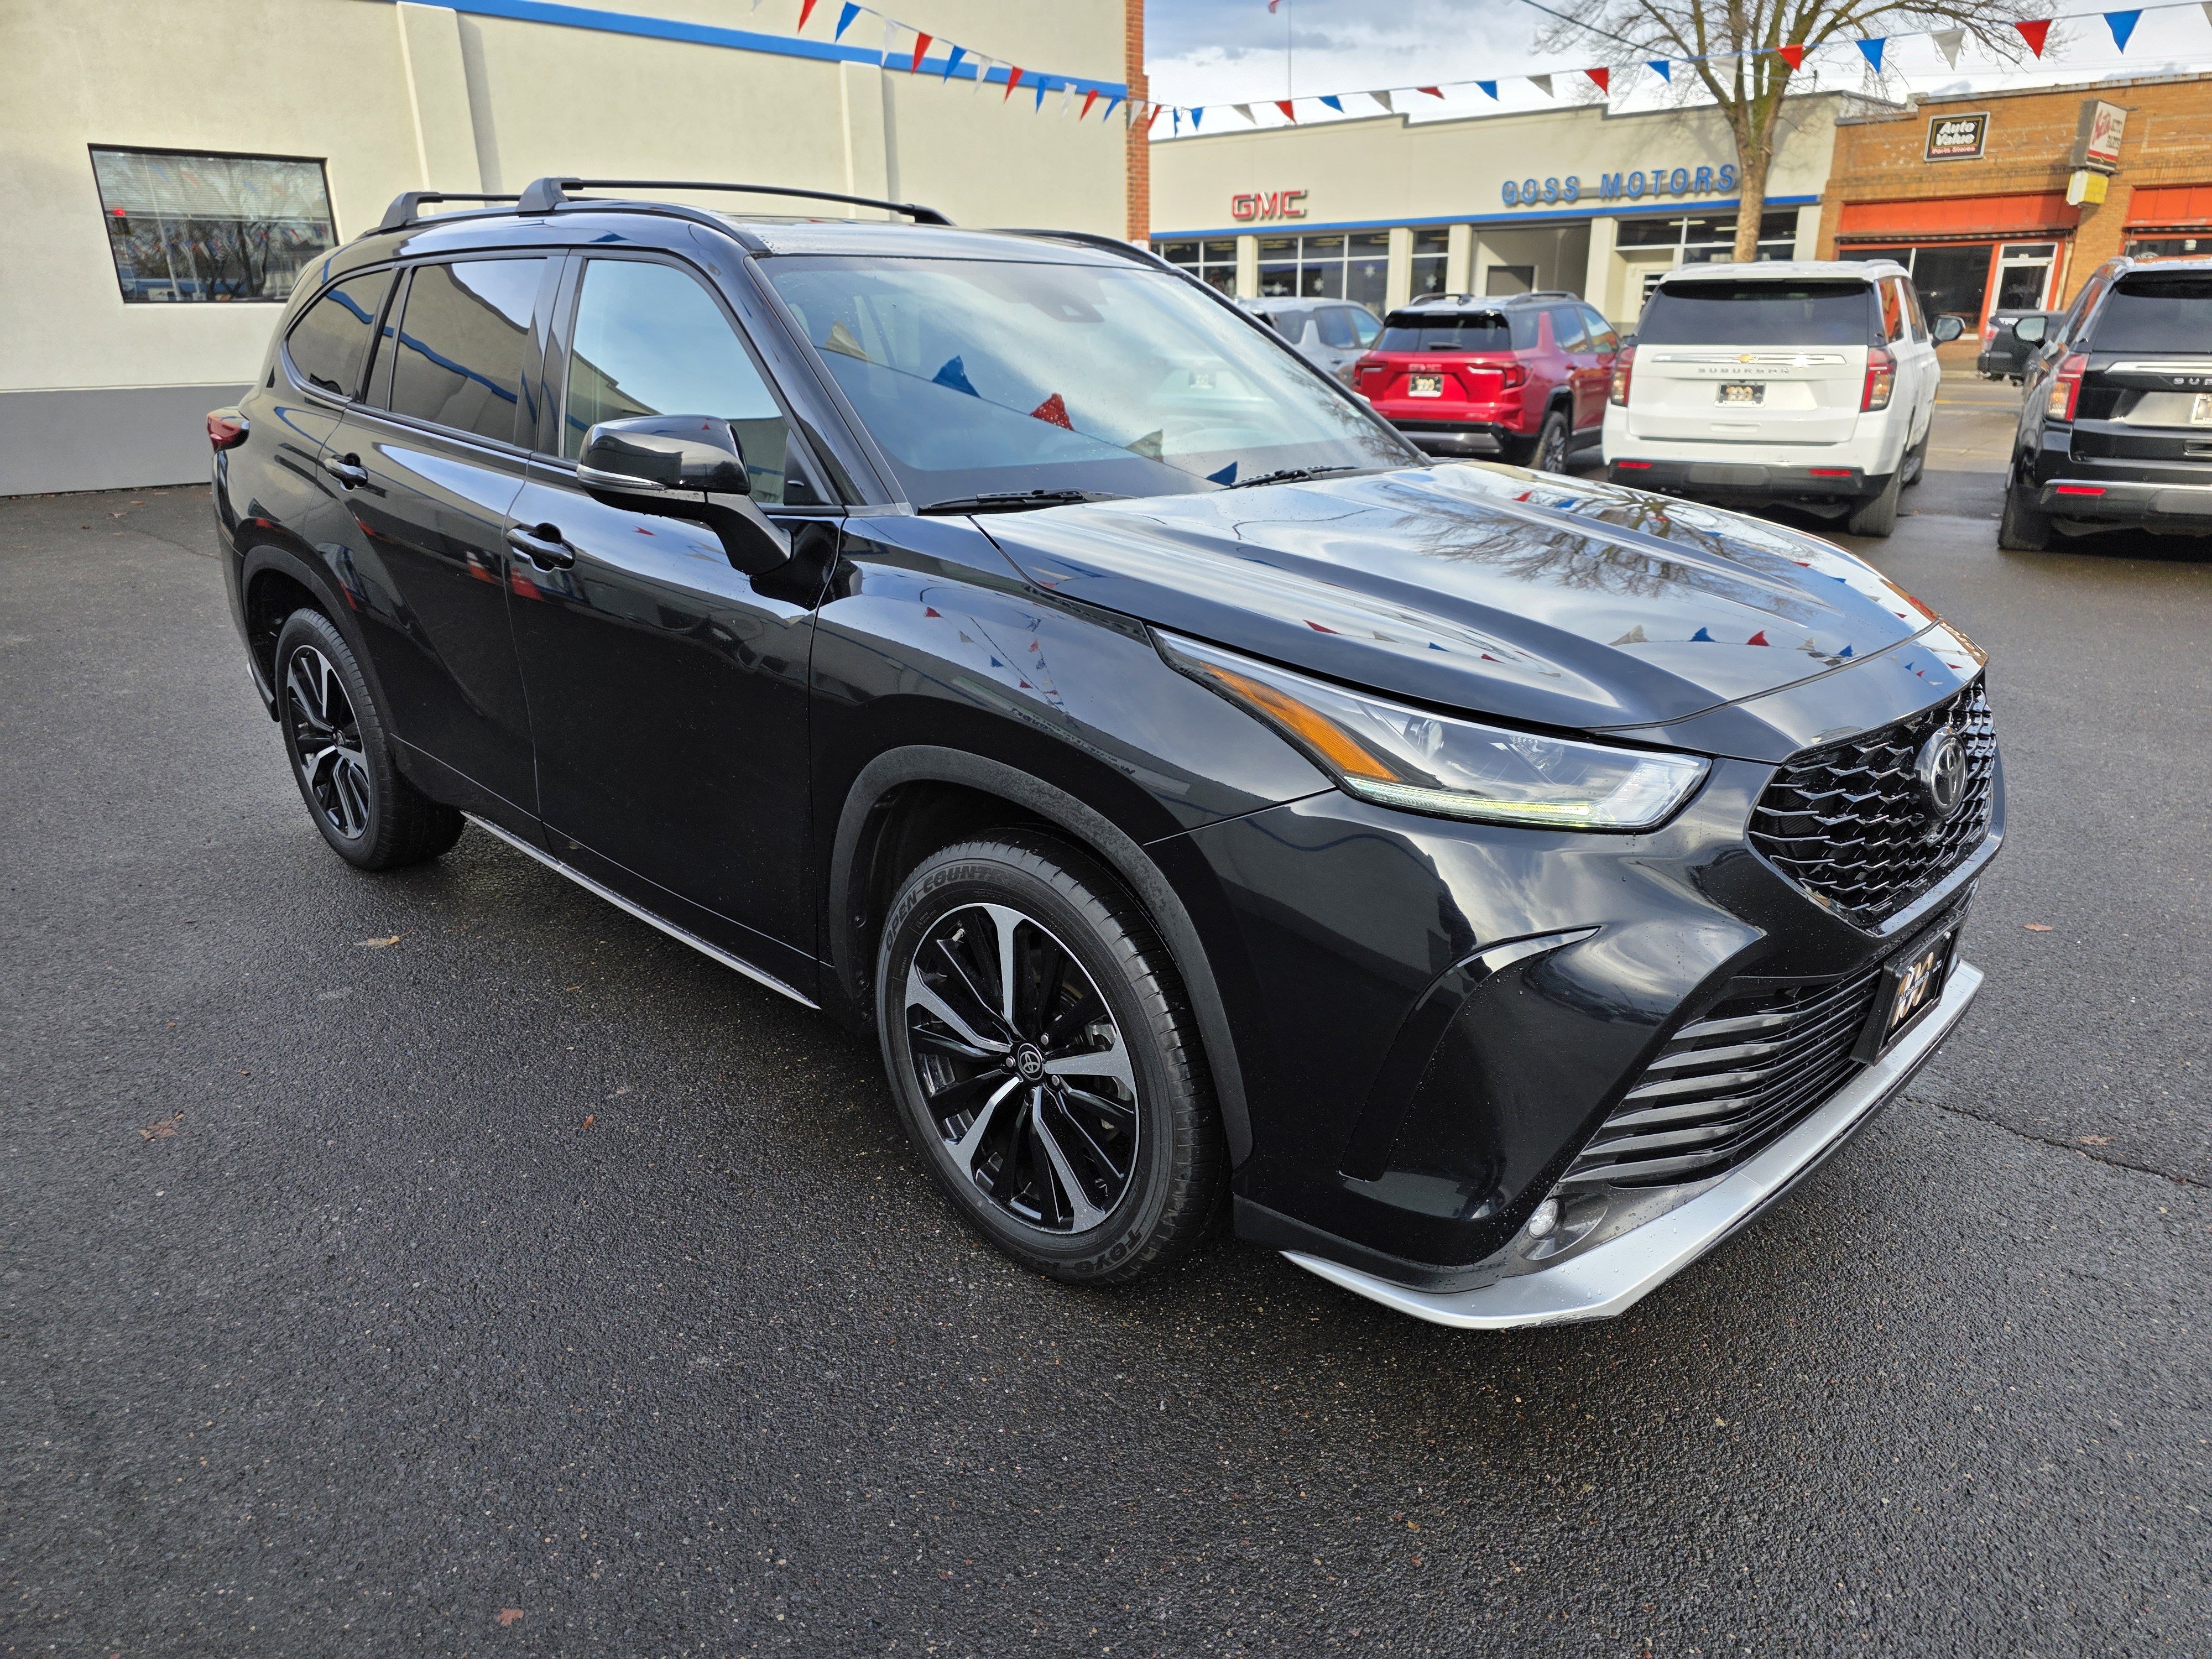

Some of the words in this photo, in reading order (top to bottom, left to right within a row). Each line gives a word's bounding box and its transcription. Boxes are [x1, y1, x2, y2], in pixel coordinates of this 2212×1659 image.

[1936, 133, 1975, 145] Value
[1939, 120, 1975, 134] Auto
[1502, 175, 1580, 205] GOSS
[1599, 164, 1738, 198] MOTORS
[1232, 190, 1306, 219] GMC
[886, 890, 917, 951] OPEN
[1074, 1229, 1143, 1272] TOYO
